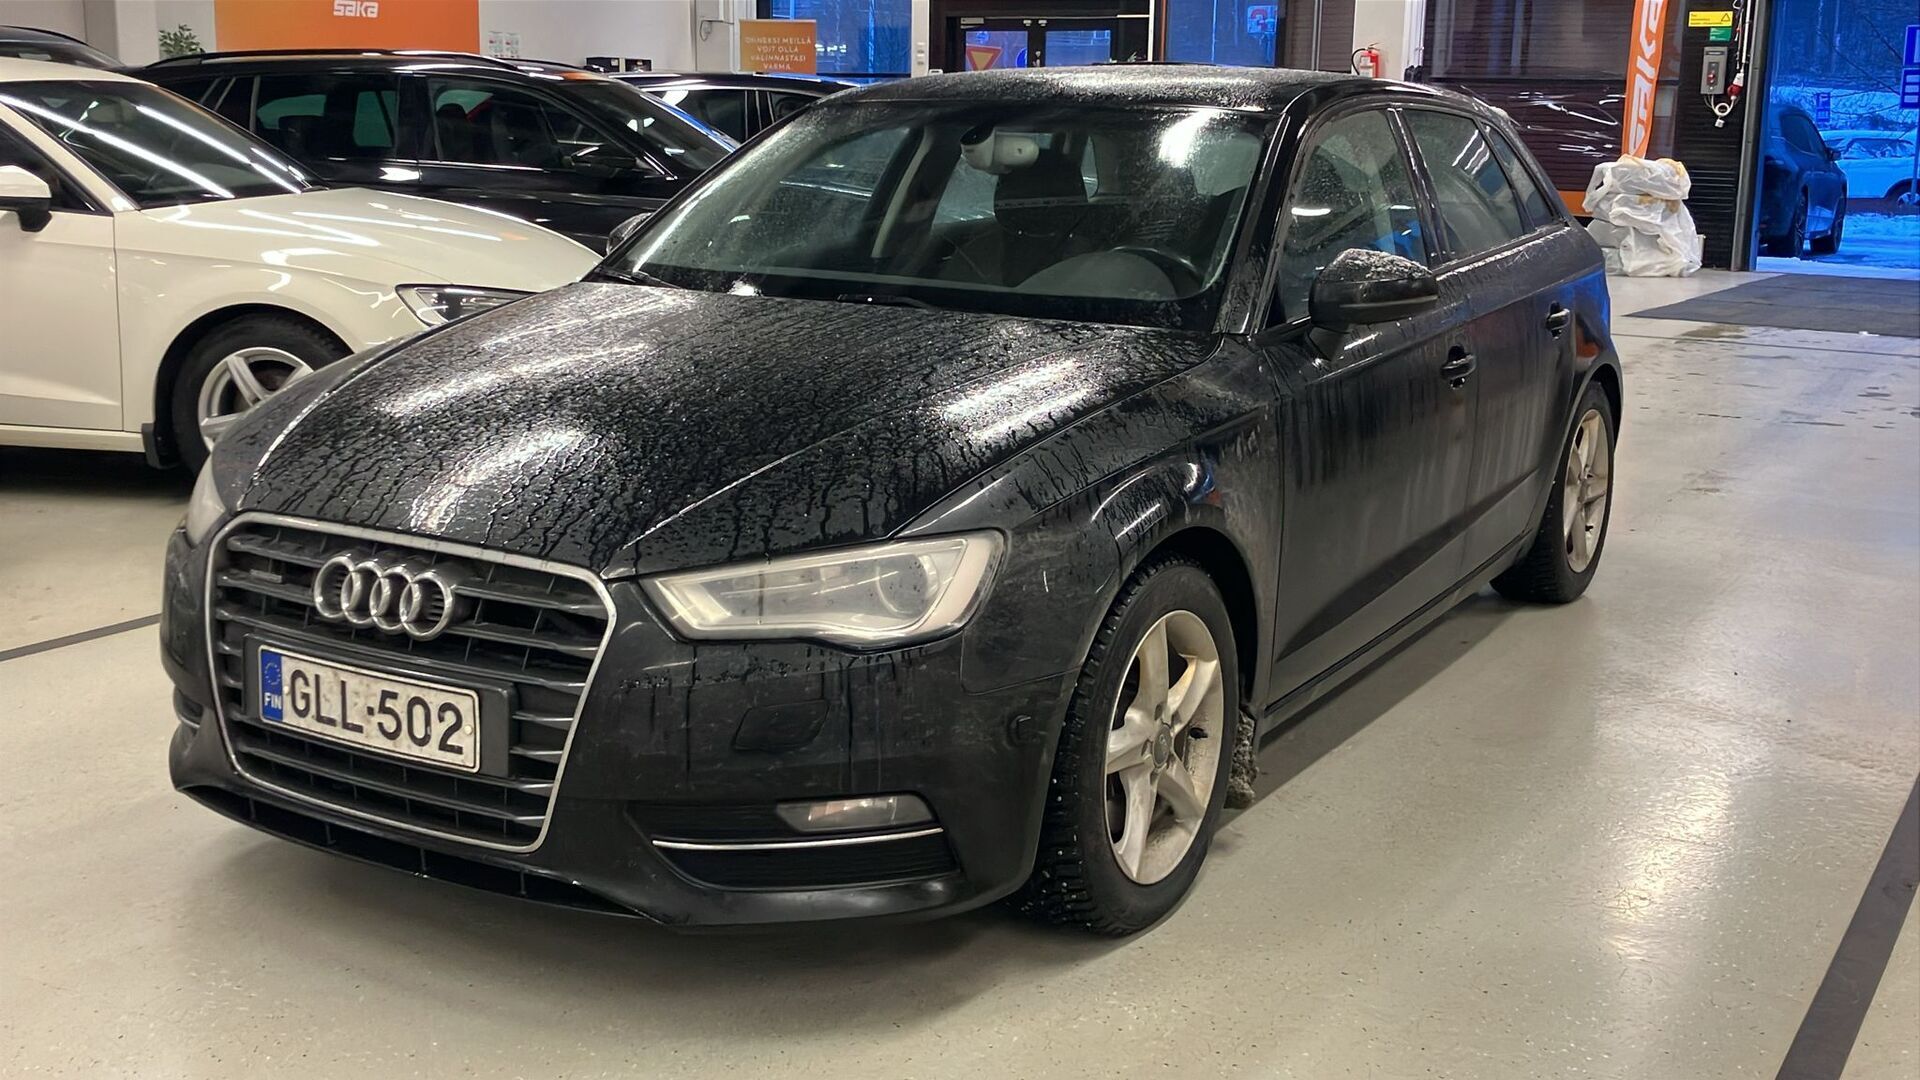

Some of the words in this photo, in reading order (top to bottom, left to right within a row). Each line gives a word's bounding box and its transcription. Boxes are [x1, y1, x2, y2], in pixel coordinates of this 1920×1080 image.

[757, 45, 775, 53] VOIT
[778, 46, 799, 54] OLLA
[763, 62, 791, 70] VARMA
[264, 691, 282, 710] FIN
[290, 669, 463, 755] GLL-502
